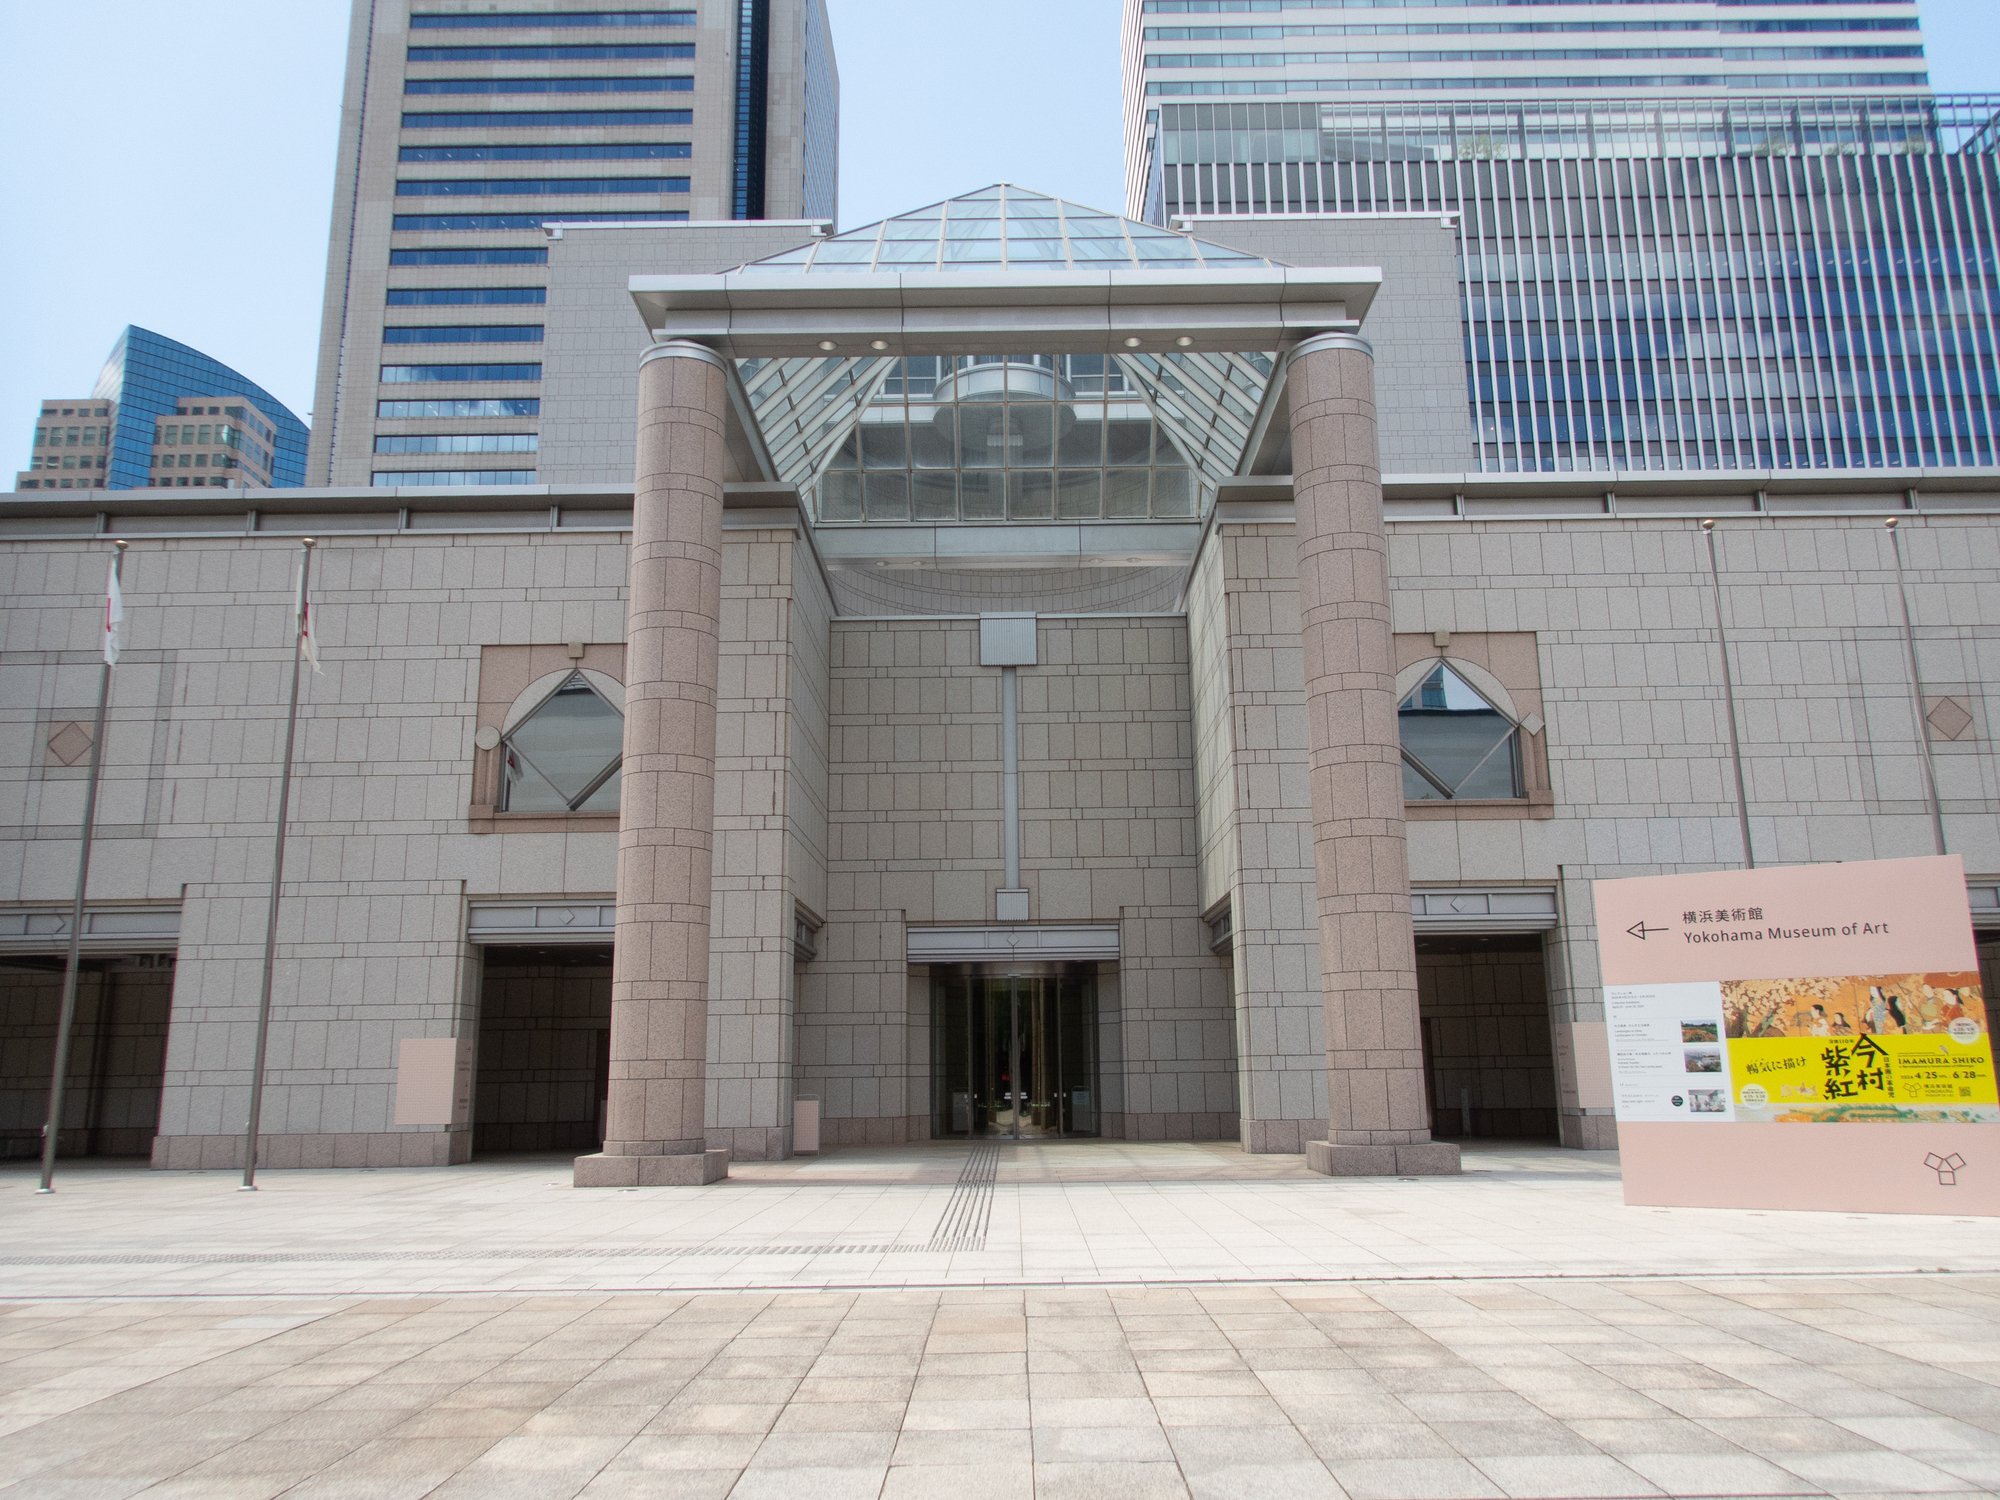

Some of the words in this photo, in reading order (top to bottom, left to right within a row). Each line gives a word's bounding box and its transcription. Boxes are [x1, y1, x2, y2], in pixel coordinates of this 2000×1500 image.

[1682, 907, 1763, 924] 横浜美術館
[1684, 928, 1763, 944] Yokohama
[1768, 926, 1836, 939] Museum
[1842, 922, 1858, 936] of
[1862, 922, 1889, 935] Art
[1898, 1057, 1950, 1065] IMAMURA
[1952, 1056, 1985, 1064] SHIKO
